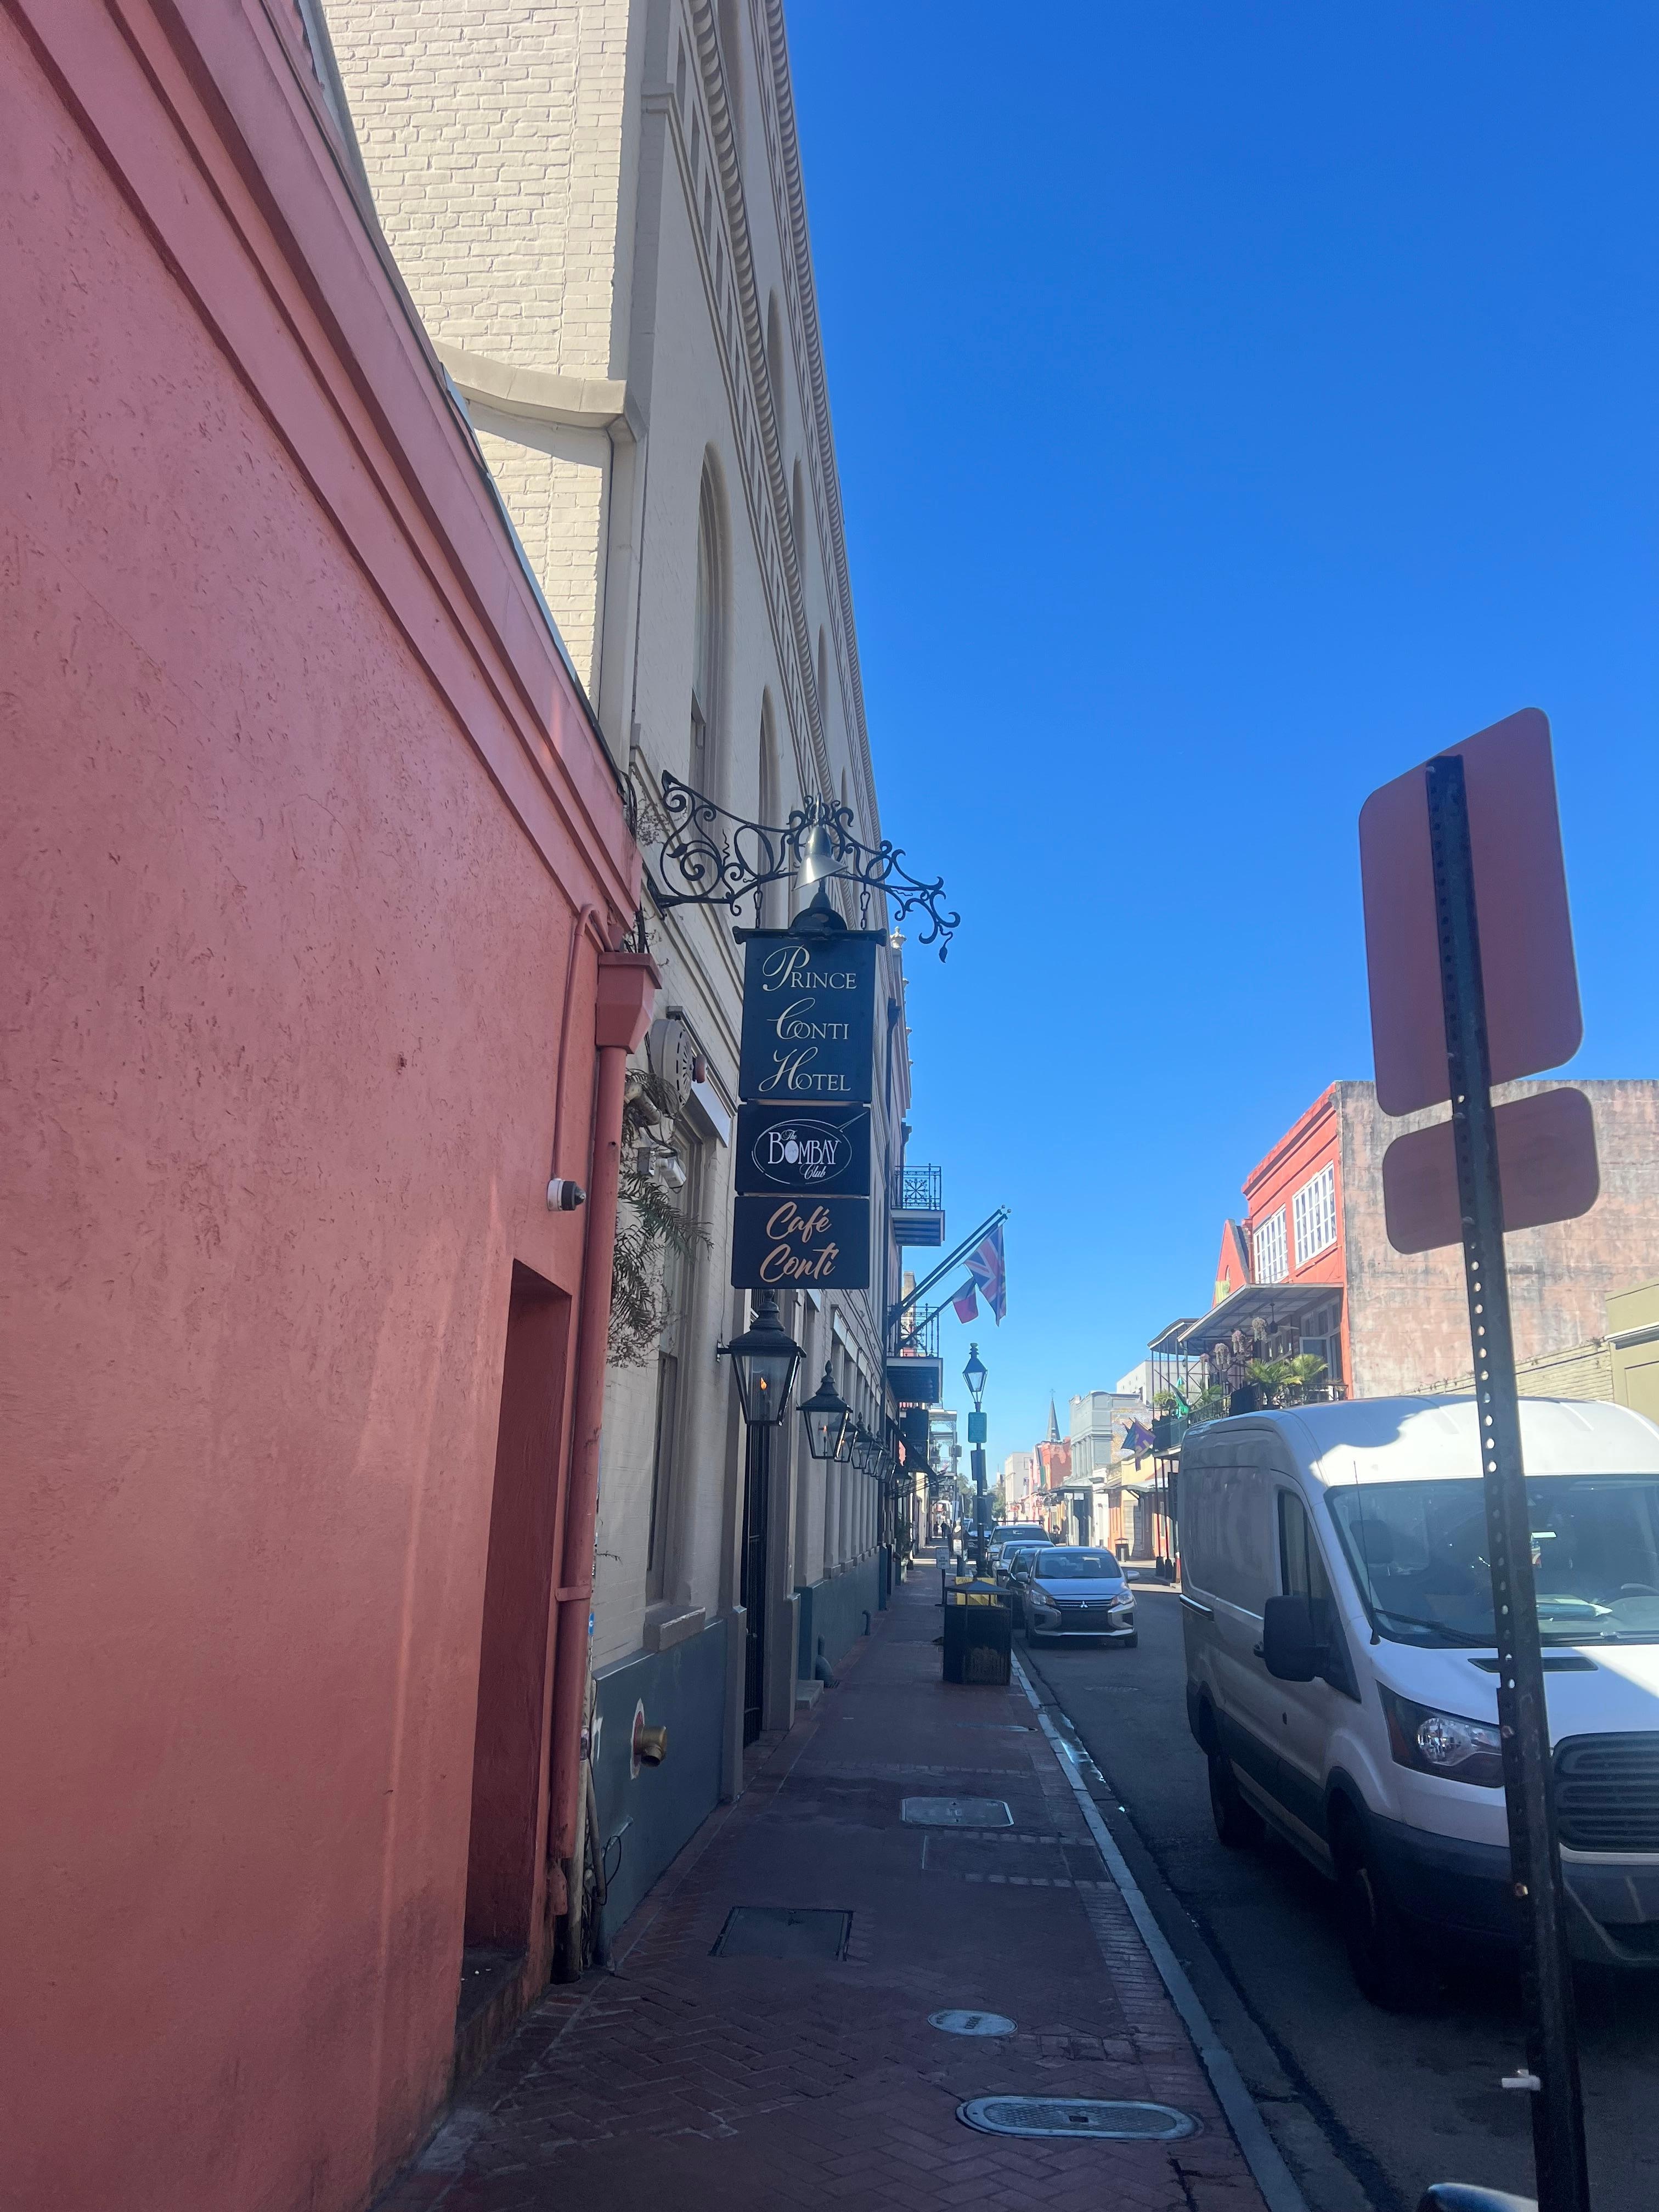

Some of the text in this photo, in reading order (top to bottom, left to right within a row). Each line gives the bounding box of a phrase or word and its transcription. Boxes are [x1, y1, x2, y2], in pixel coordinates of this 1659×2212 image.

[763, 944, 857, 991] PRINCE
[767, 997, 849, 1040] CONTI
[758, 1046, 851, 1092] HOTEL
[768, 1131, 839, 1165] BOMBAY
[799, 1163, 826, 1180] Club
[766, 1201, 832, 1243] Café
[760, 1242, 839, 1283] Conti
